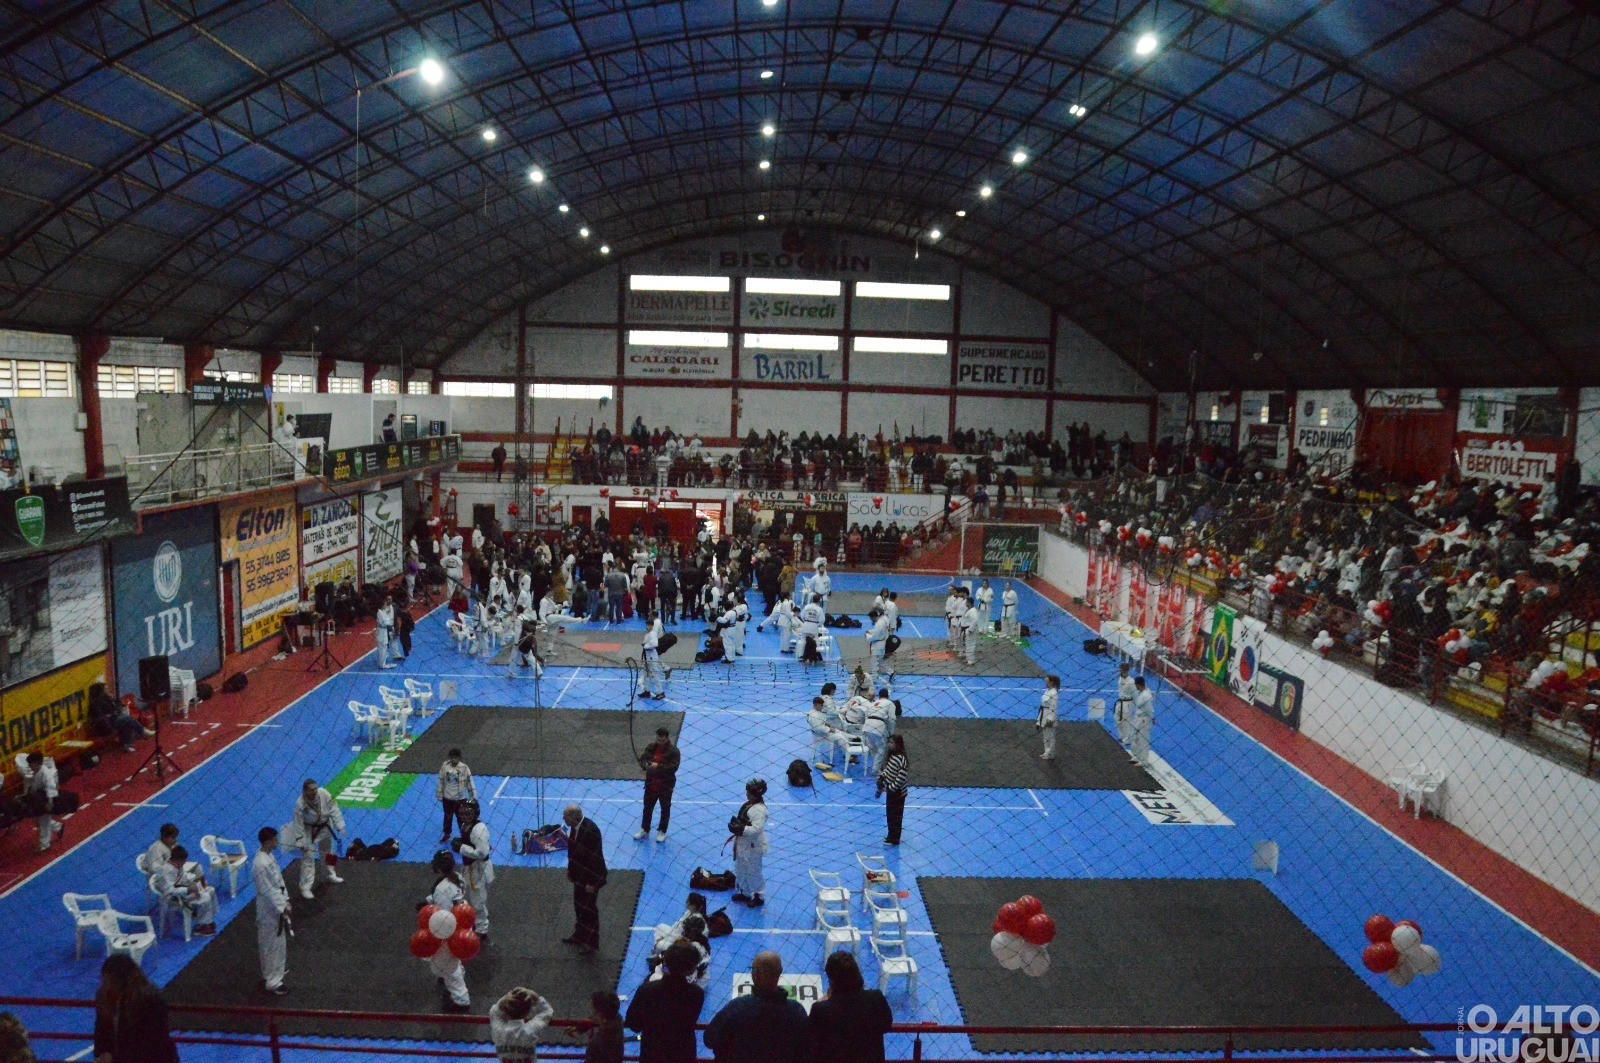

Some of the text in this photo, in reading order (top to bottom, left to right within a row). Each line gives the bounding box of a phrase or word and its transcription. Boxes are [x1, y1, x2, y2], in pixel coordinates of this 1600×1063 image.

[772, 298, 836, 319] Sicredi
[629, 355, 720, 365] CALEGARI
[960, 346, 1046, 360] SUPERMERCADO
[753, 352, 831, 380] BARRIL
[959, 364, 1045, 385] PERETTO
[1299, 429, 1354, 450] PEDRINHO
[1467, 453, 1549, 478] BERTOLETTI
[885, 496, 929, 517] Lucas
[236, 506, 286, 542] Elton
[144, 601, 195, 658] URI
